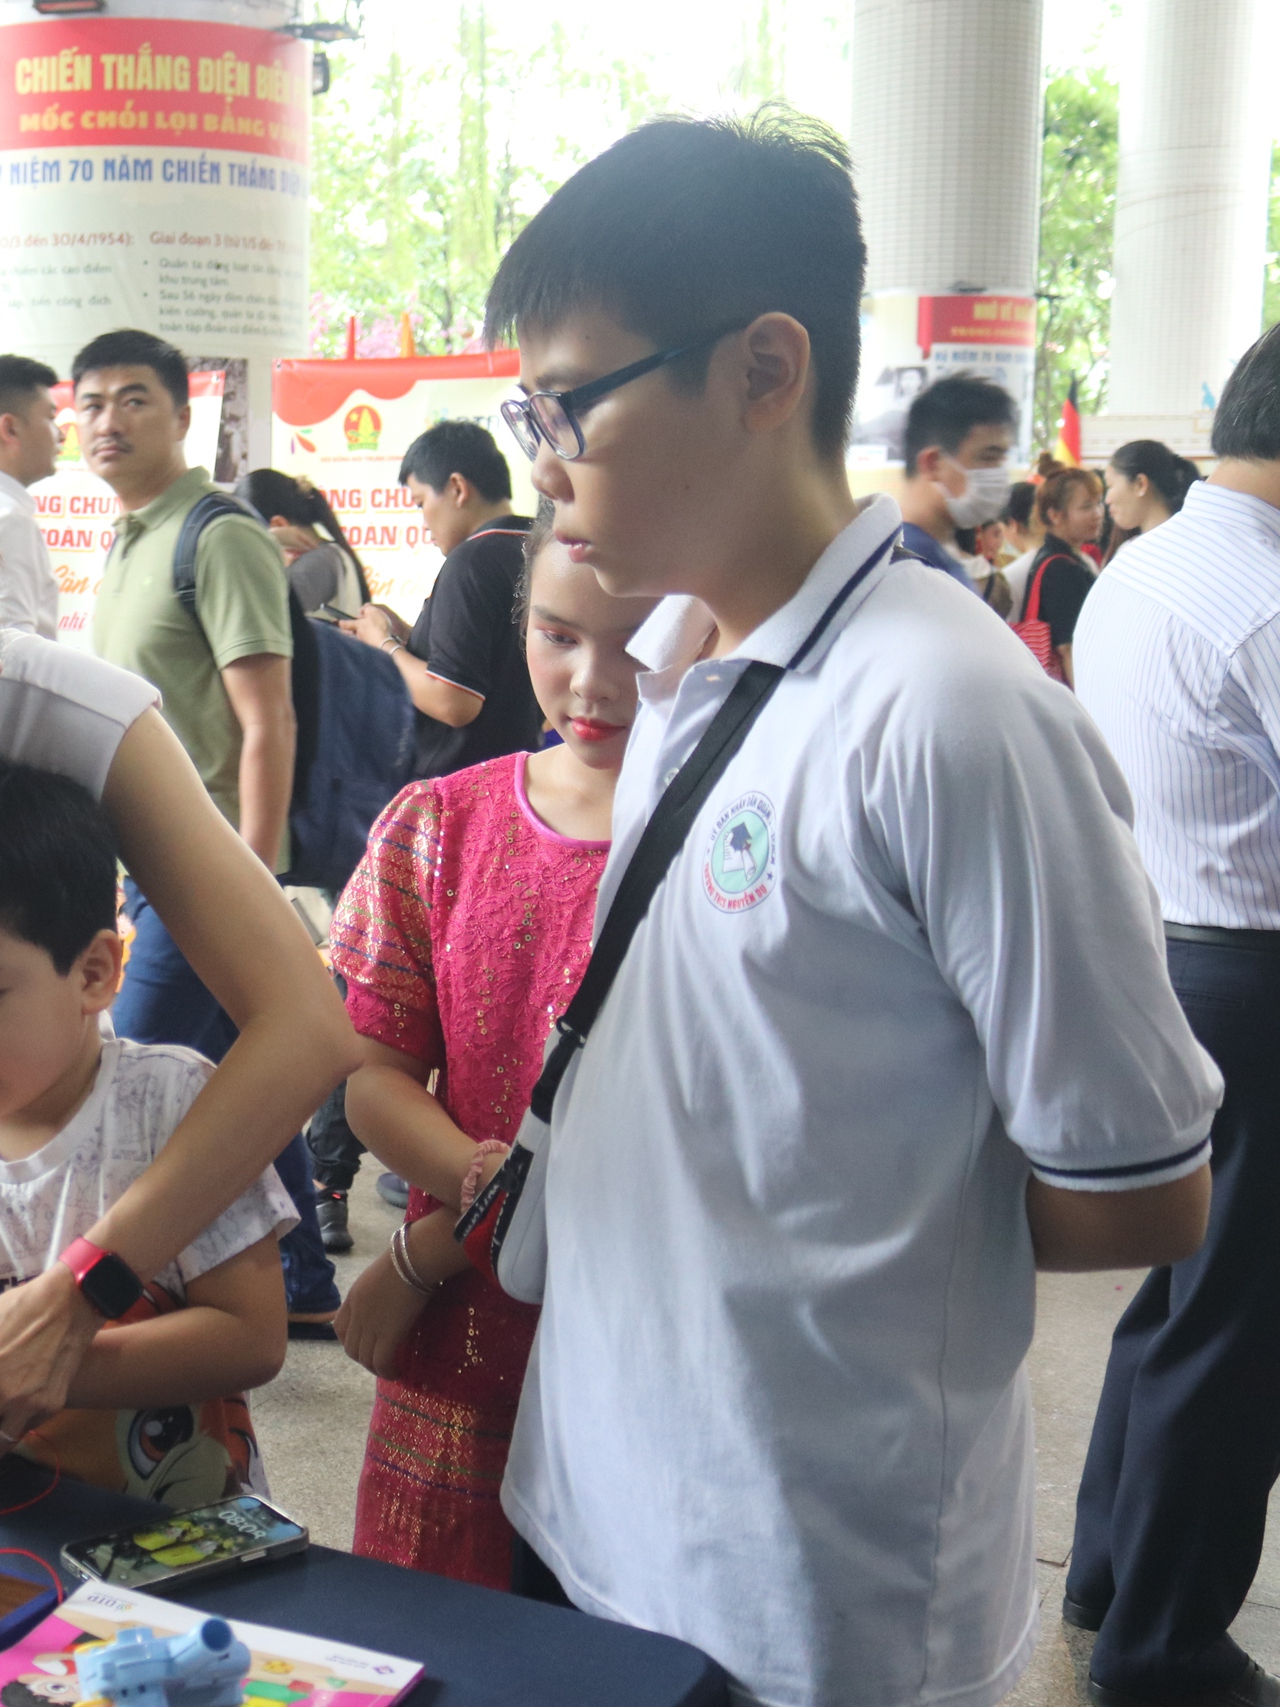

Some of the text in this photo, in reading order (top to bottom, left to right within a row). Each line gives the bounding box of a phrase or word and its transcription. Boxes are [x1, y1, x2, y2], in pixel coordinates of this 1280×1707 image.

[15, 46, 92, 94] CHIẾN
[69, 159, 93, 182] 70
[103, 154, 153, 182] NĂM
